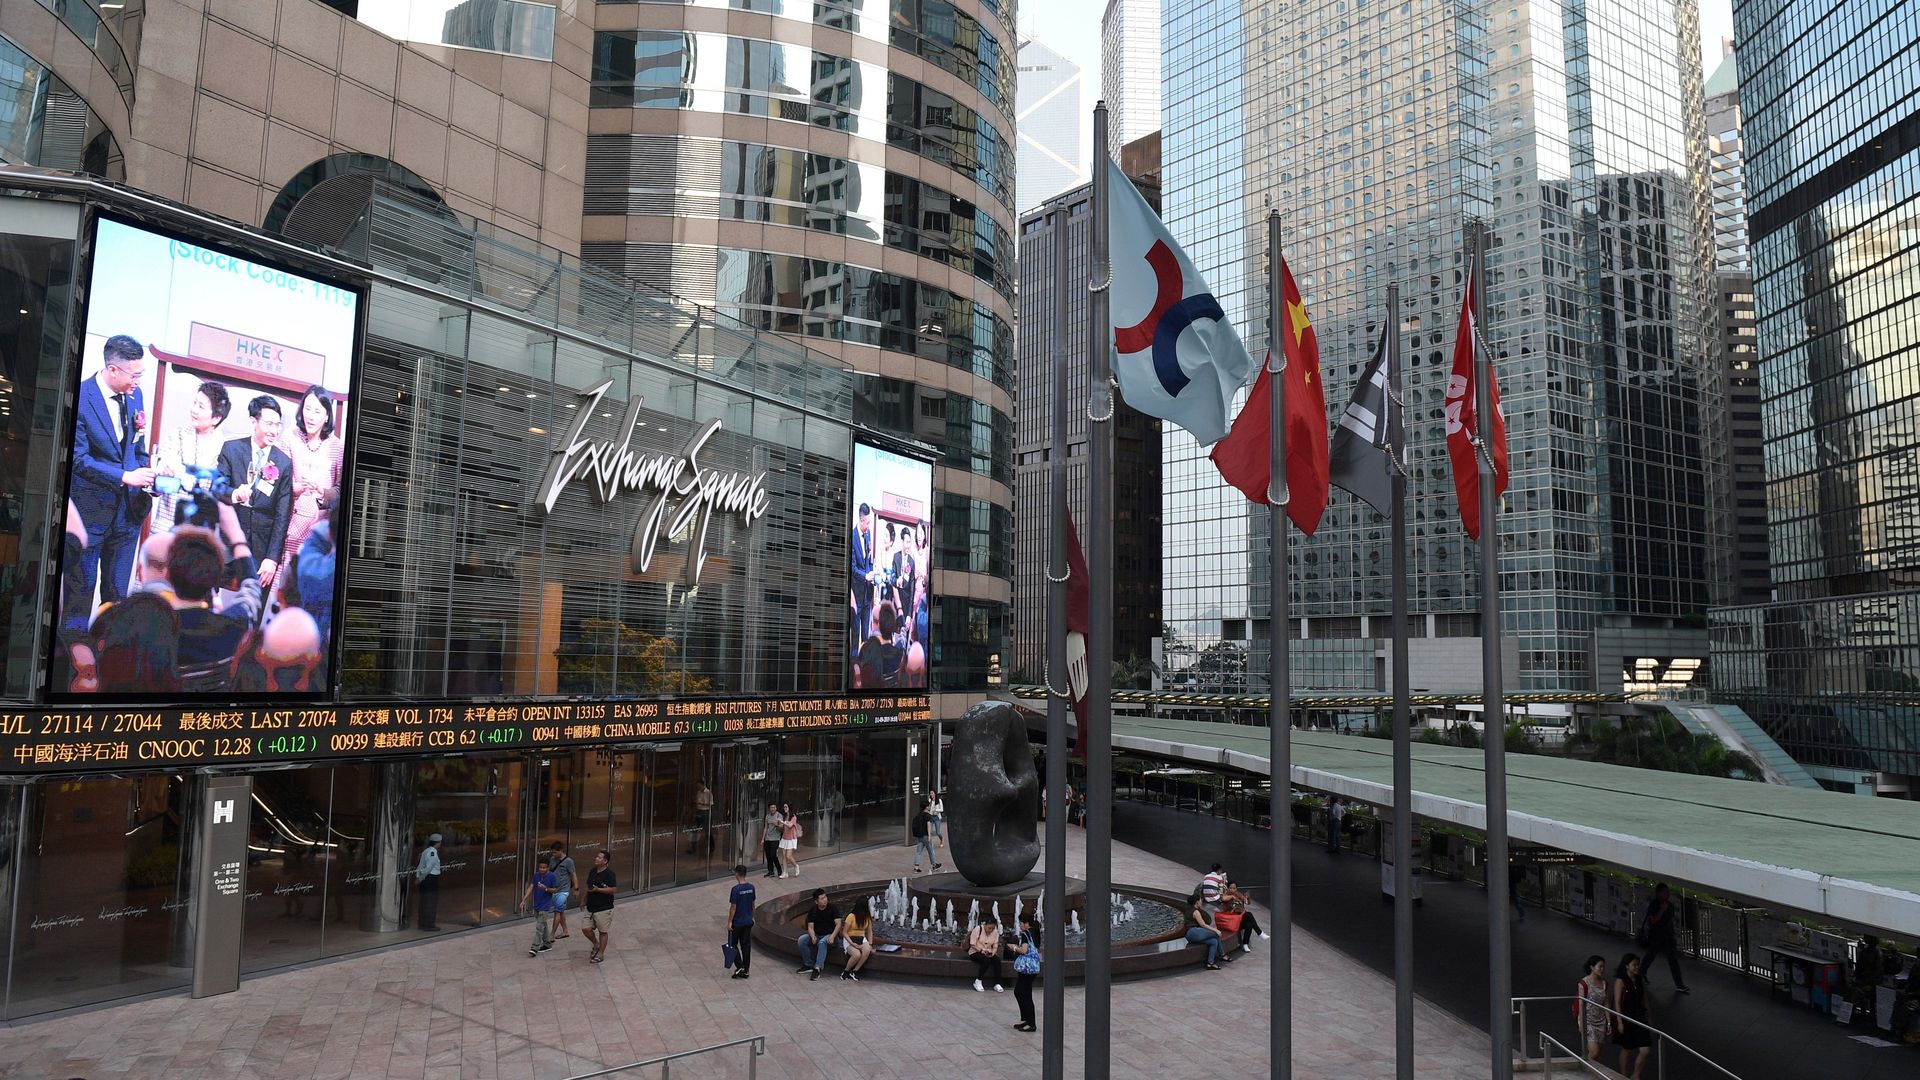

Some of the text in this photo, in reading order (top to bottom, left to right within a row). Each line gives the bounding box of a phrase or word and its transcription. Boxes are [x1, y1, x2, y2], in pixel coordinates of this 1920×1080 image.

[246, 261, 304, 293] Code:
[537, 378, 771, 587] Exchange Square
[41, 715, 93, 734] 27114
[100, 715, 109, 731] /
[113, 714, 162, 732] 27044
[179, 711, 244, 731] 最後成交
[250, 711, 292, 729] LAST
[298, 710, 337, 727] 27074
[350, 709, 390, 726] 成交額
[395, 709, 422, 725] VOL
[428, 708, 453, 724] 1734
[463, 706, 518, 722] 未平倉合約
[522, 706, 551, 721] OPEN
[553, 705, 571, 720] INT
[576, 705, 605, 719] 133155
[613, 704, 632, 718] EAS
[635, 703, 658, 717] 26993
[715, 702, 729, 715] HSI
[729, 701, 762, 714] FUTURES
[765, 700, 777, 712] 下月
[779, 701, 798, 712] NEXT
[799, 700, 822, 711] MONTH
[14, 742, 129, 765] 中國海洋石油
[138, 739, 205, 759] CNOOC
[213, 738, 251, 756] 12.28
[331, 733, 369, 751] 00939
[373, 731, 424, 748] 建設銀行
[428, 730, 455, 747] CCB
[459, 729, 476, 745] 6.2
[532, 727, 560, 742] 00941
[564, 725, 601, 739] 中國移動
[604, 723, 634, 738] CHINA
[636, 721, 671, 736] MOBILE
[674, 721, 690, 734] 67.3
[723, 719, 744, 731] 01038
[786, 716, 799, 728] CKI
[800, 715, 832, 727] HOLDINGS
